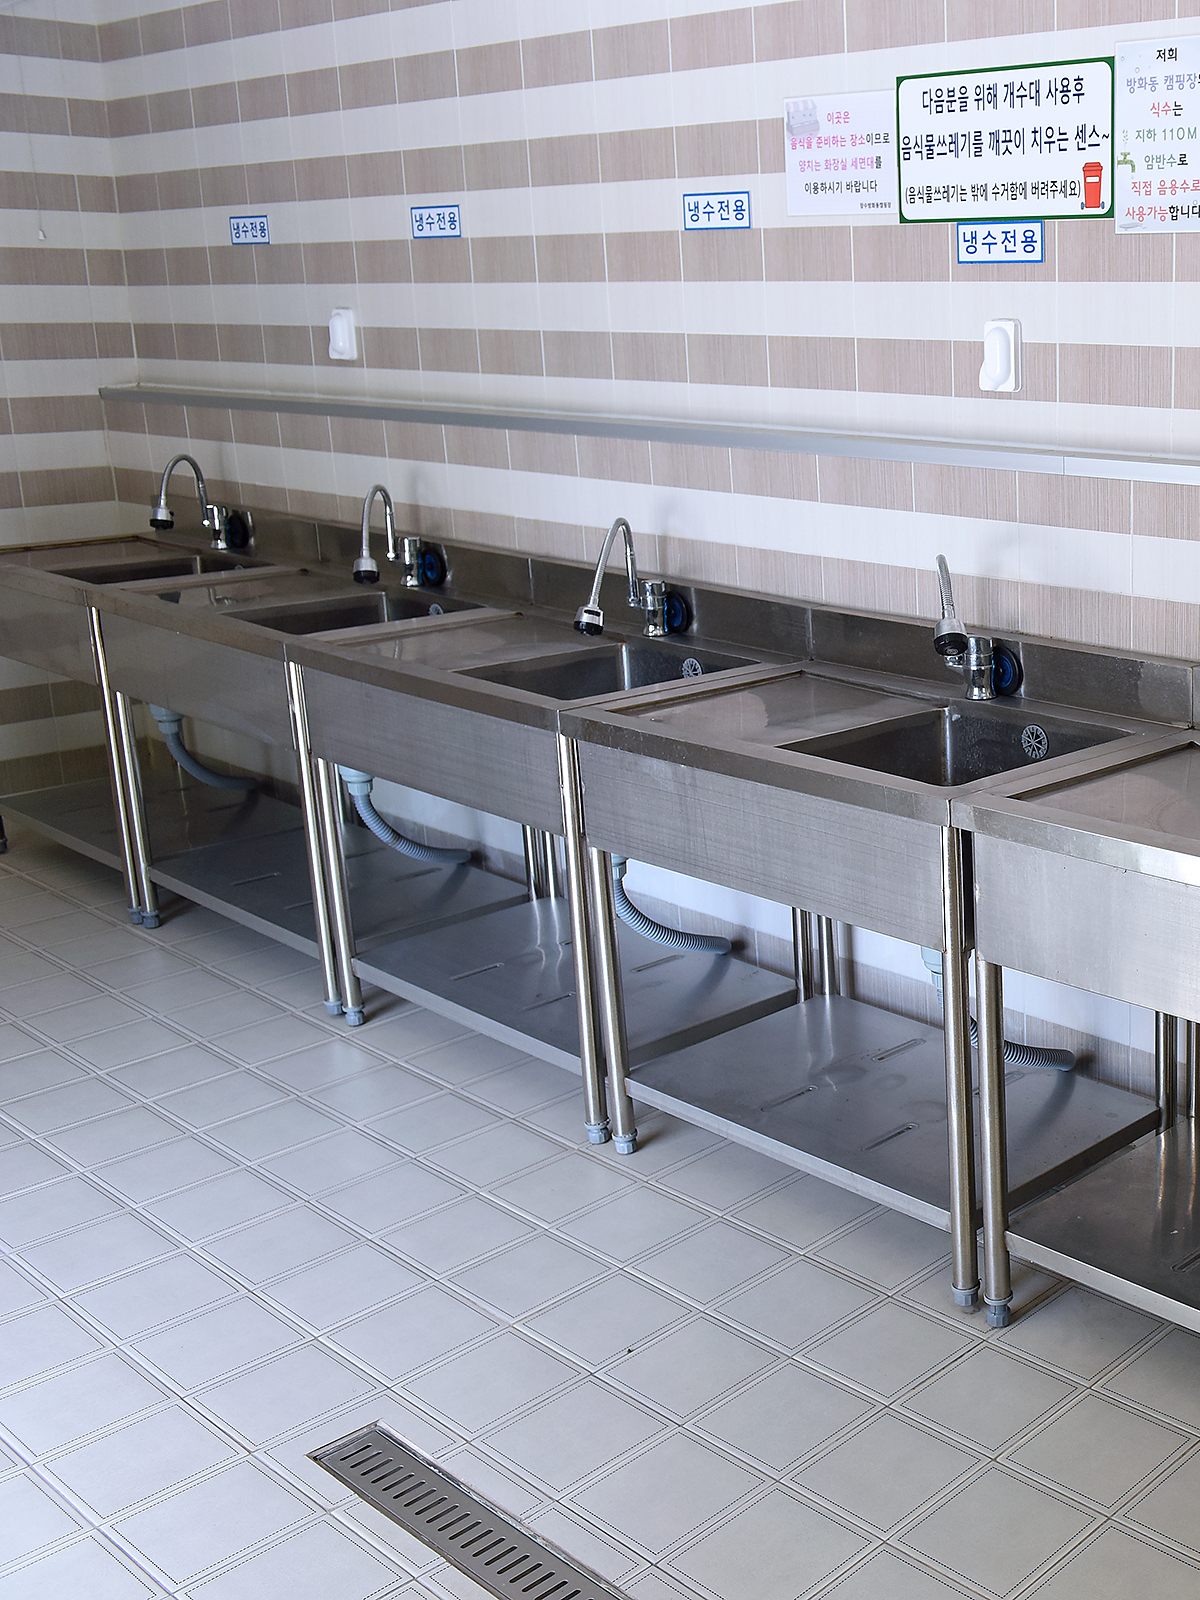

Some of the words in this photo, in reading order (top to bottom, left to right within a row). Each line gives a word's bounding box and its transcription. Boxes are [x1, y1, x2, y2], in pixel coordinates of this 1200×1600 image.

[1156, 48, 1178, 62] 저희
[1126, 76, 1158, 94] 방화동
[922, 86, 969, 114] 다음분을
[974, 83, 998, 111] 위해
[1003, 79, 1040, 108] 개수대
[1046, 76, 1085, 105] 사용후
[826, 111, 850, 124] 이곳은
[1150, 101, 1183, 118] 식수는
[791, 136, 812, 150] 음식을
[816, 136, 846, 148] 준비하는
[850, 133, 890, 146] 장소이므로
[902, 131, 984, 160] 음식물쓰레기를
[988, 128, 1025, 156] 깨끗이
[1031, 126, 1068, 154] 치우는
[1135, 128, 1156, 142] 지하
[798, 160, 821, 172] 양치는
[824, 158, 848, 171] 화장실
[850, 156, 882, 170] 세면대를
[1144, 154, 1188, 170] 암반수로
[804, 181, 842, 194] 이용하시기
[846, 180, 878, 193] 바랍니다
[905, 184, 968, 204] (음식물쓰레기는
[971, 183, 988, 202] 밖에
[992, 181, 1027, 201] 수거함에
[1030, 180, 1081, 200] 버려주세요)
[1132, 181, 1152, 196] 직접
[1157, 179, 1200, 196] 음용수로
[688, 199, 746, 222] 냉수전용
[232, 221, 266, 238] 냉수전용
[414, 211, 457, 232] 냉수전용
[962, 229, 1038, 254] 냉수전용
